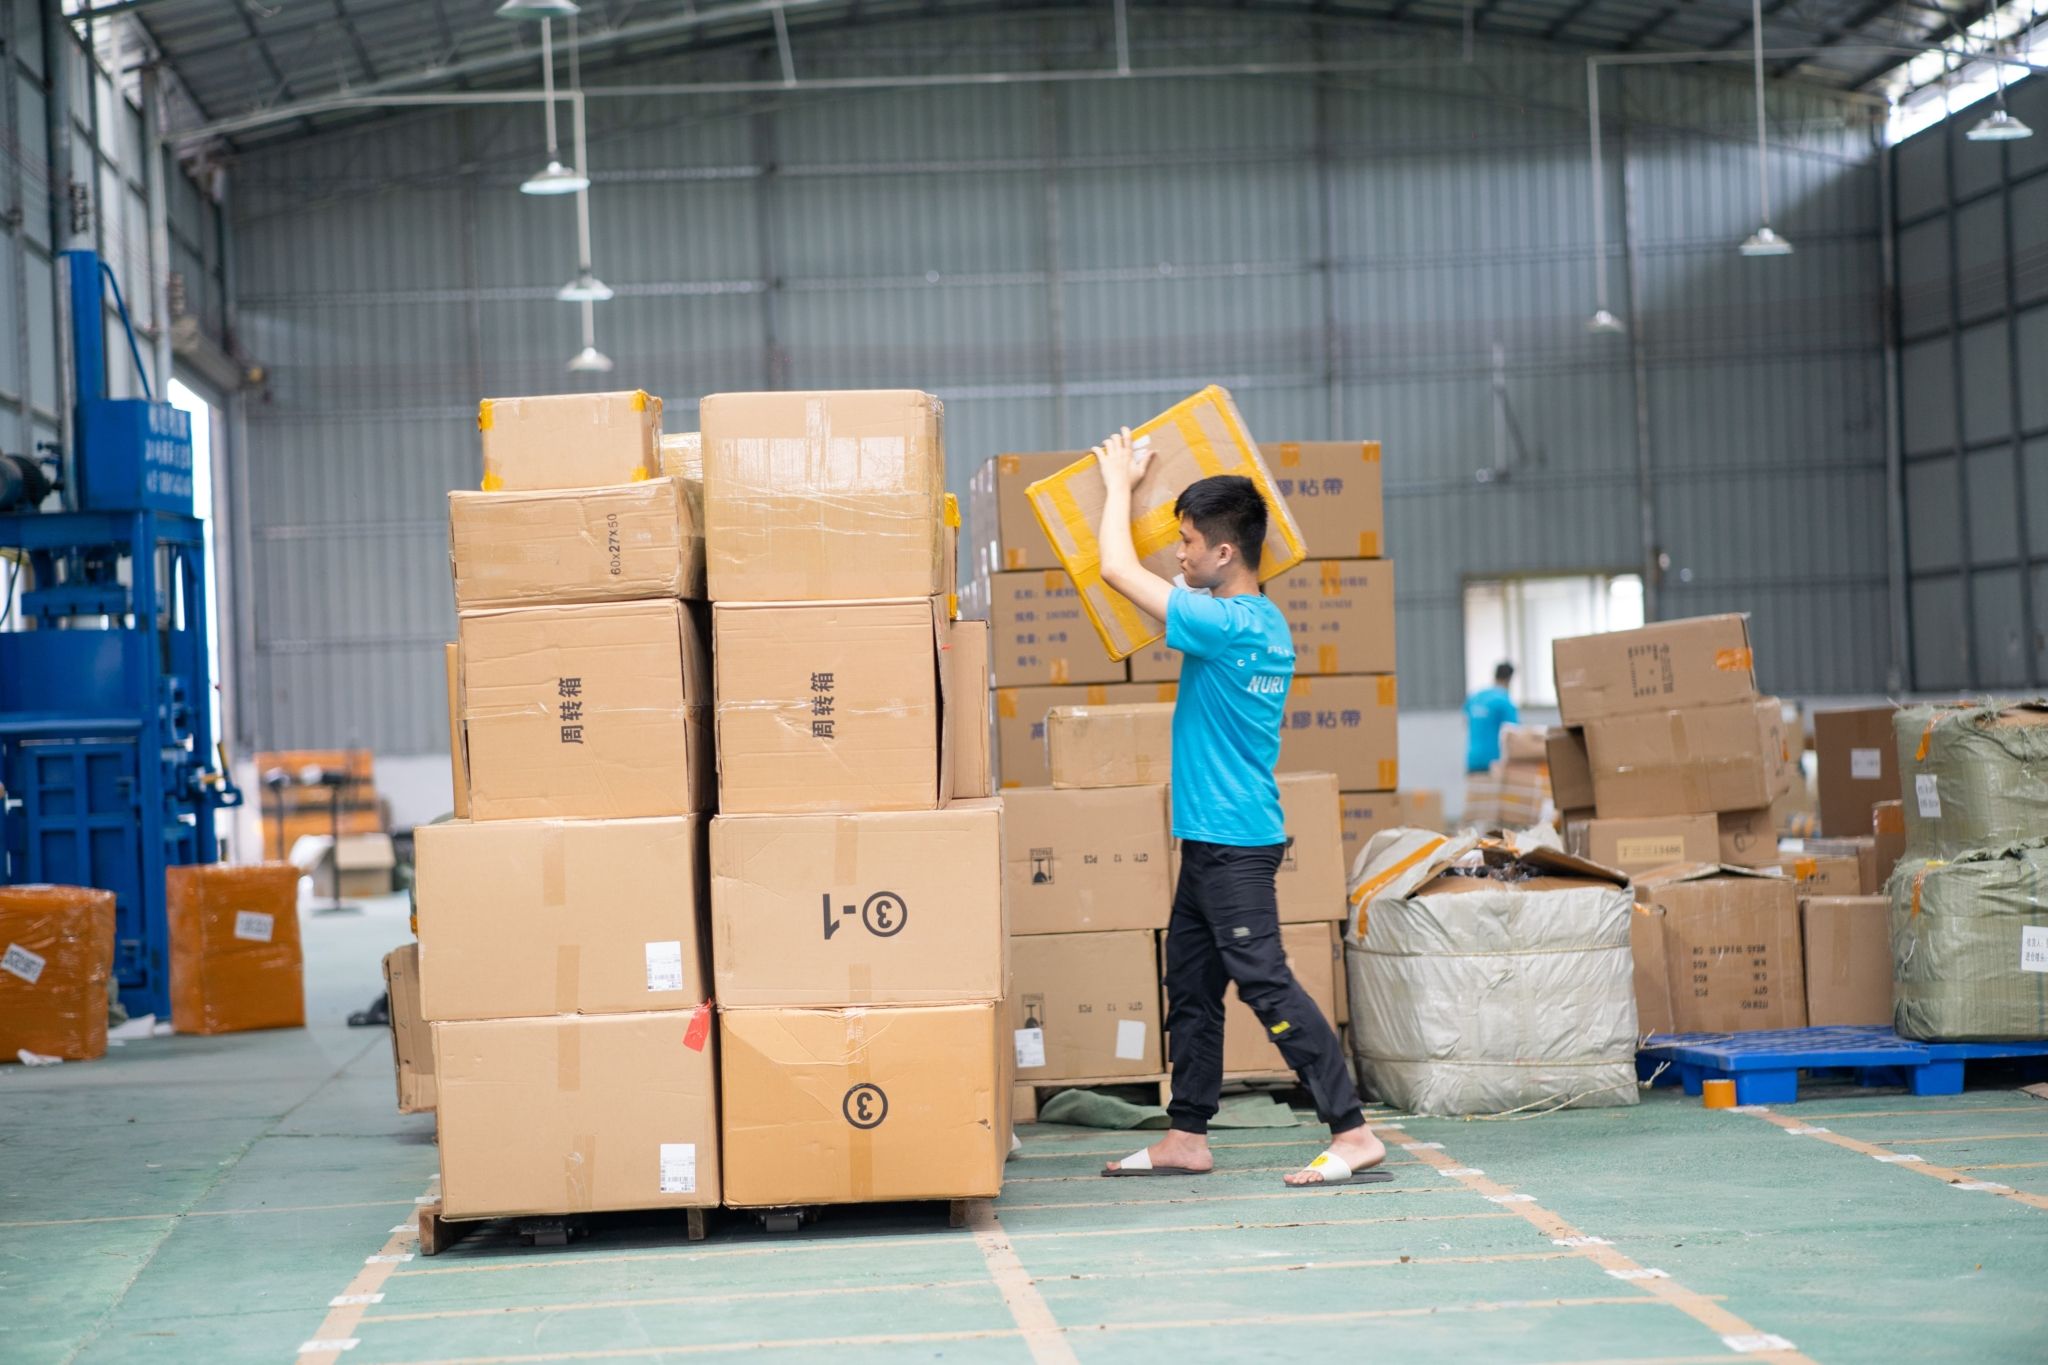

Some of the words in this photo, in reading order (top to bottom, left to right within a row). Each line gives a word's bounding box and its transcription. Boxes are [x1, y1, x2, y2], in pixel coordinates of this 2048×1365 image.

[558, 677, 584, 744] 周转箱
[810, 672, 835, 740] 周转箱
